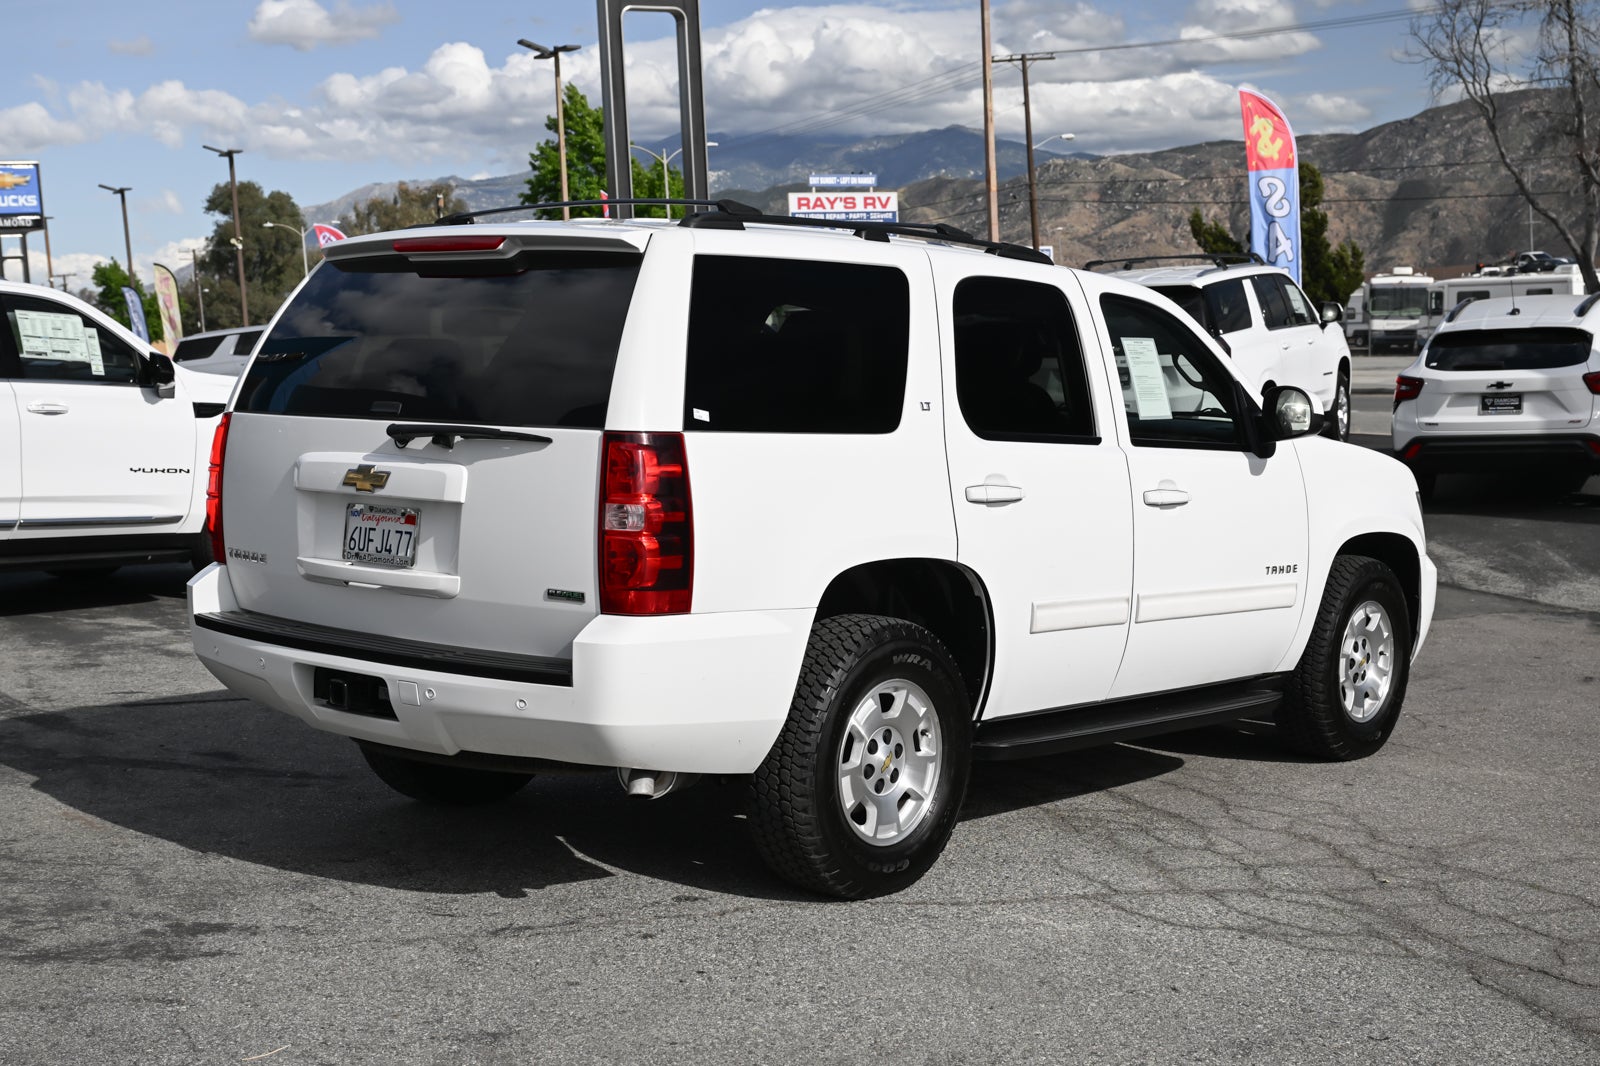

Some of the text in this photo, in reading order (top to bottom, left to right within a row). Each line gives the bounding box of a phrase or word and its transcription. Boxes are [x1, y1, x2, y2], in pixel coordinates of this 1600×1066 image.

[797, 196, 891, 210] RAY'S RV
[849, 212, 867, 220] PARTS
[348, 526, 413, 557] 6UFJ477
[1265, 564, 1298, 575] TAHOE
